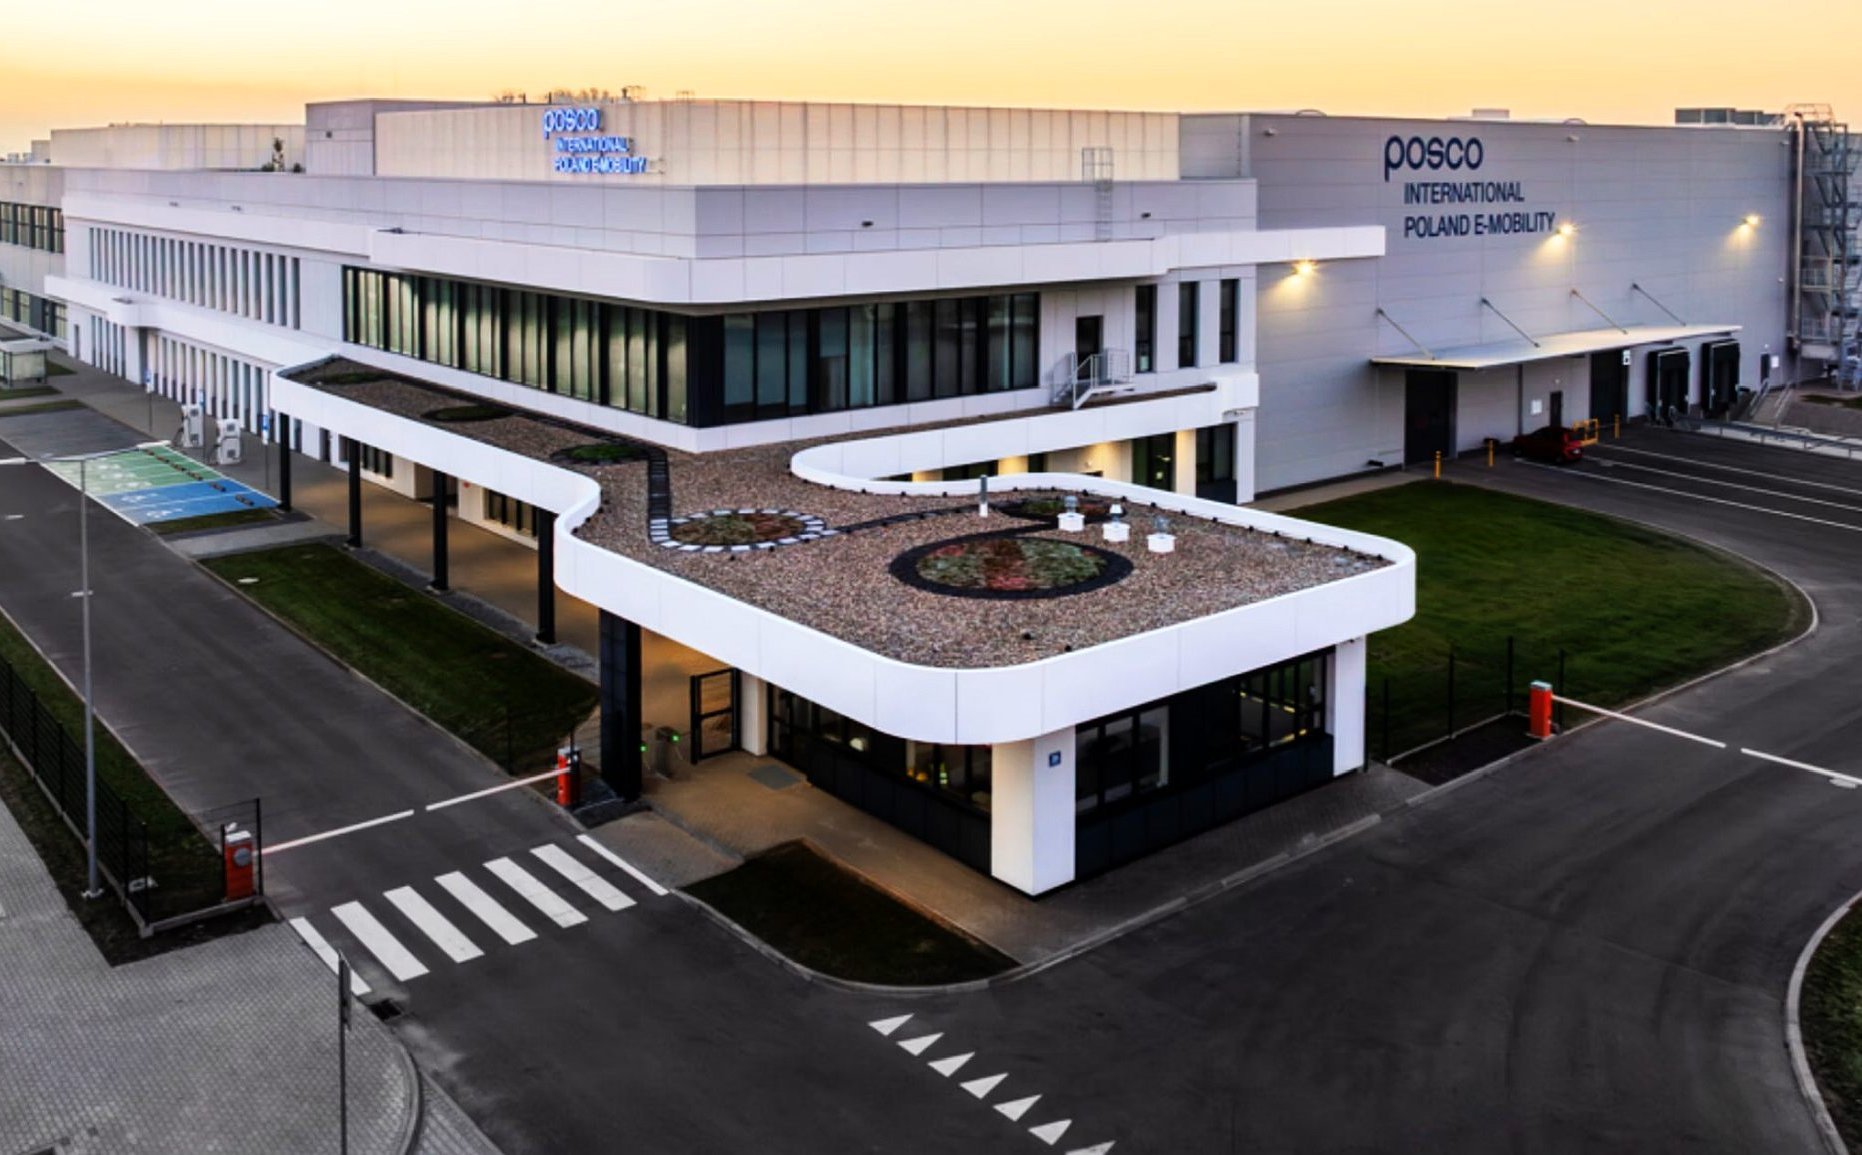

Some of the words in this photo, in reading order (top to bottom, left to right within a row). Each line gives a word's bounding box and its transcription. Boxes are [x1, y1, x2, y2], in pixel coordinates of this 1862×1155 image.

[1384, 135, 1484, 182] posco
[1404, 182, 1525, 204] INTERNATIONAL
[1404, 215, 1470, 238] POLAND
[1474, 212, 1556, 235] E-MOBILITY
